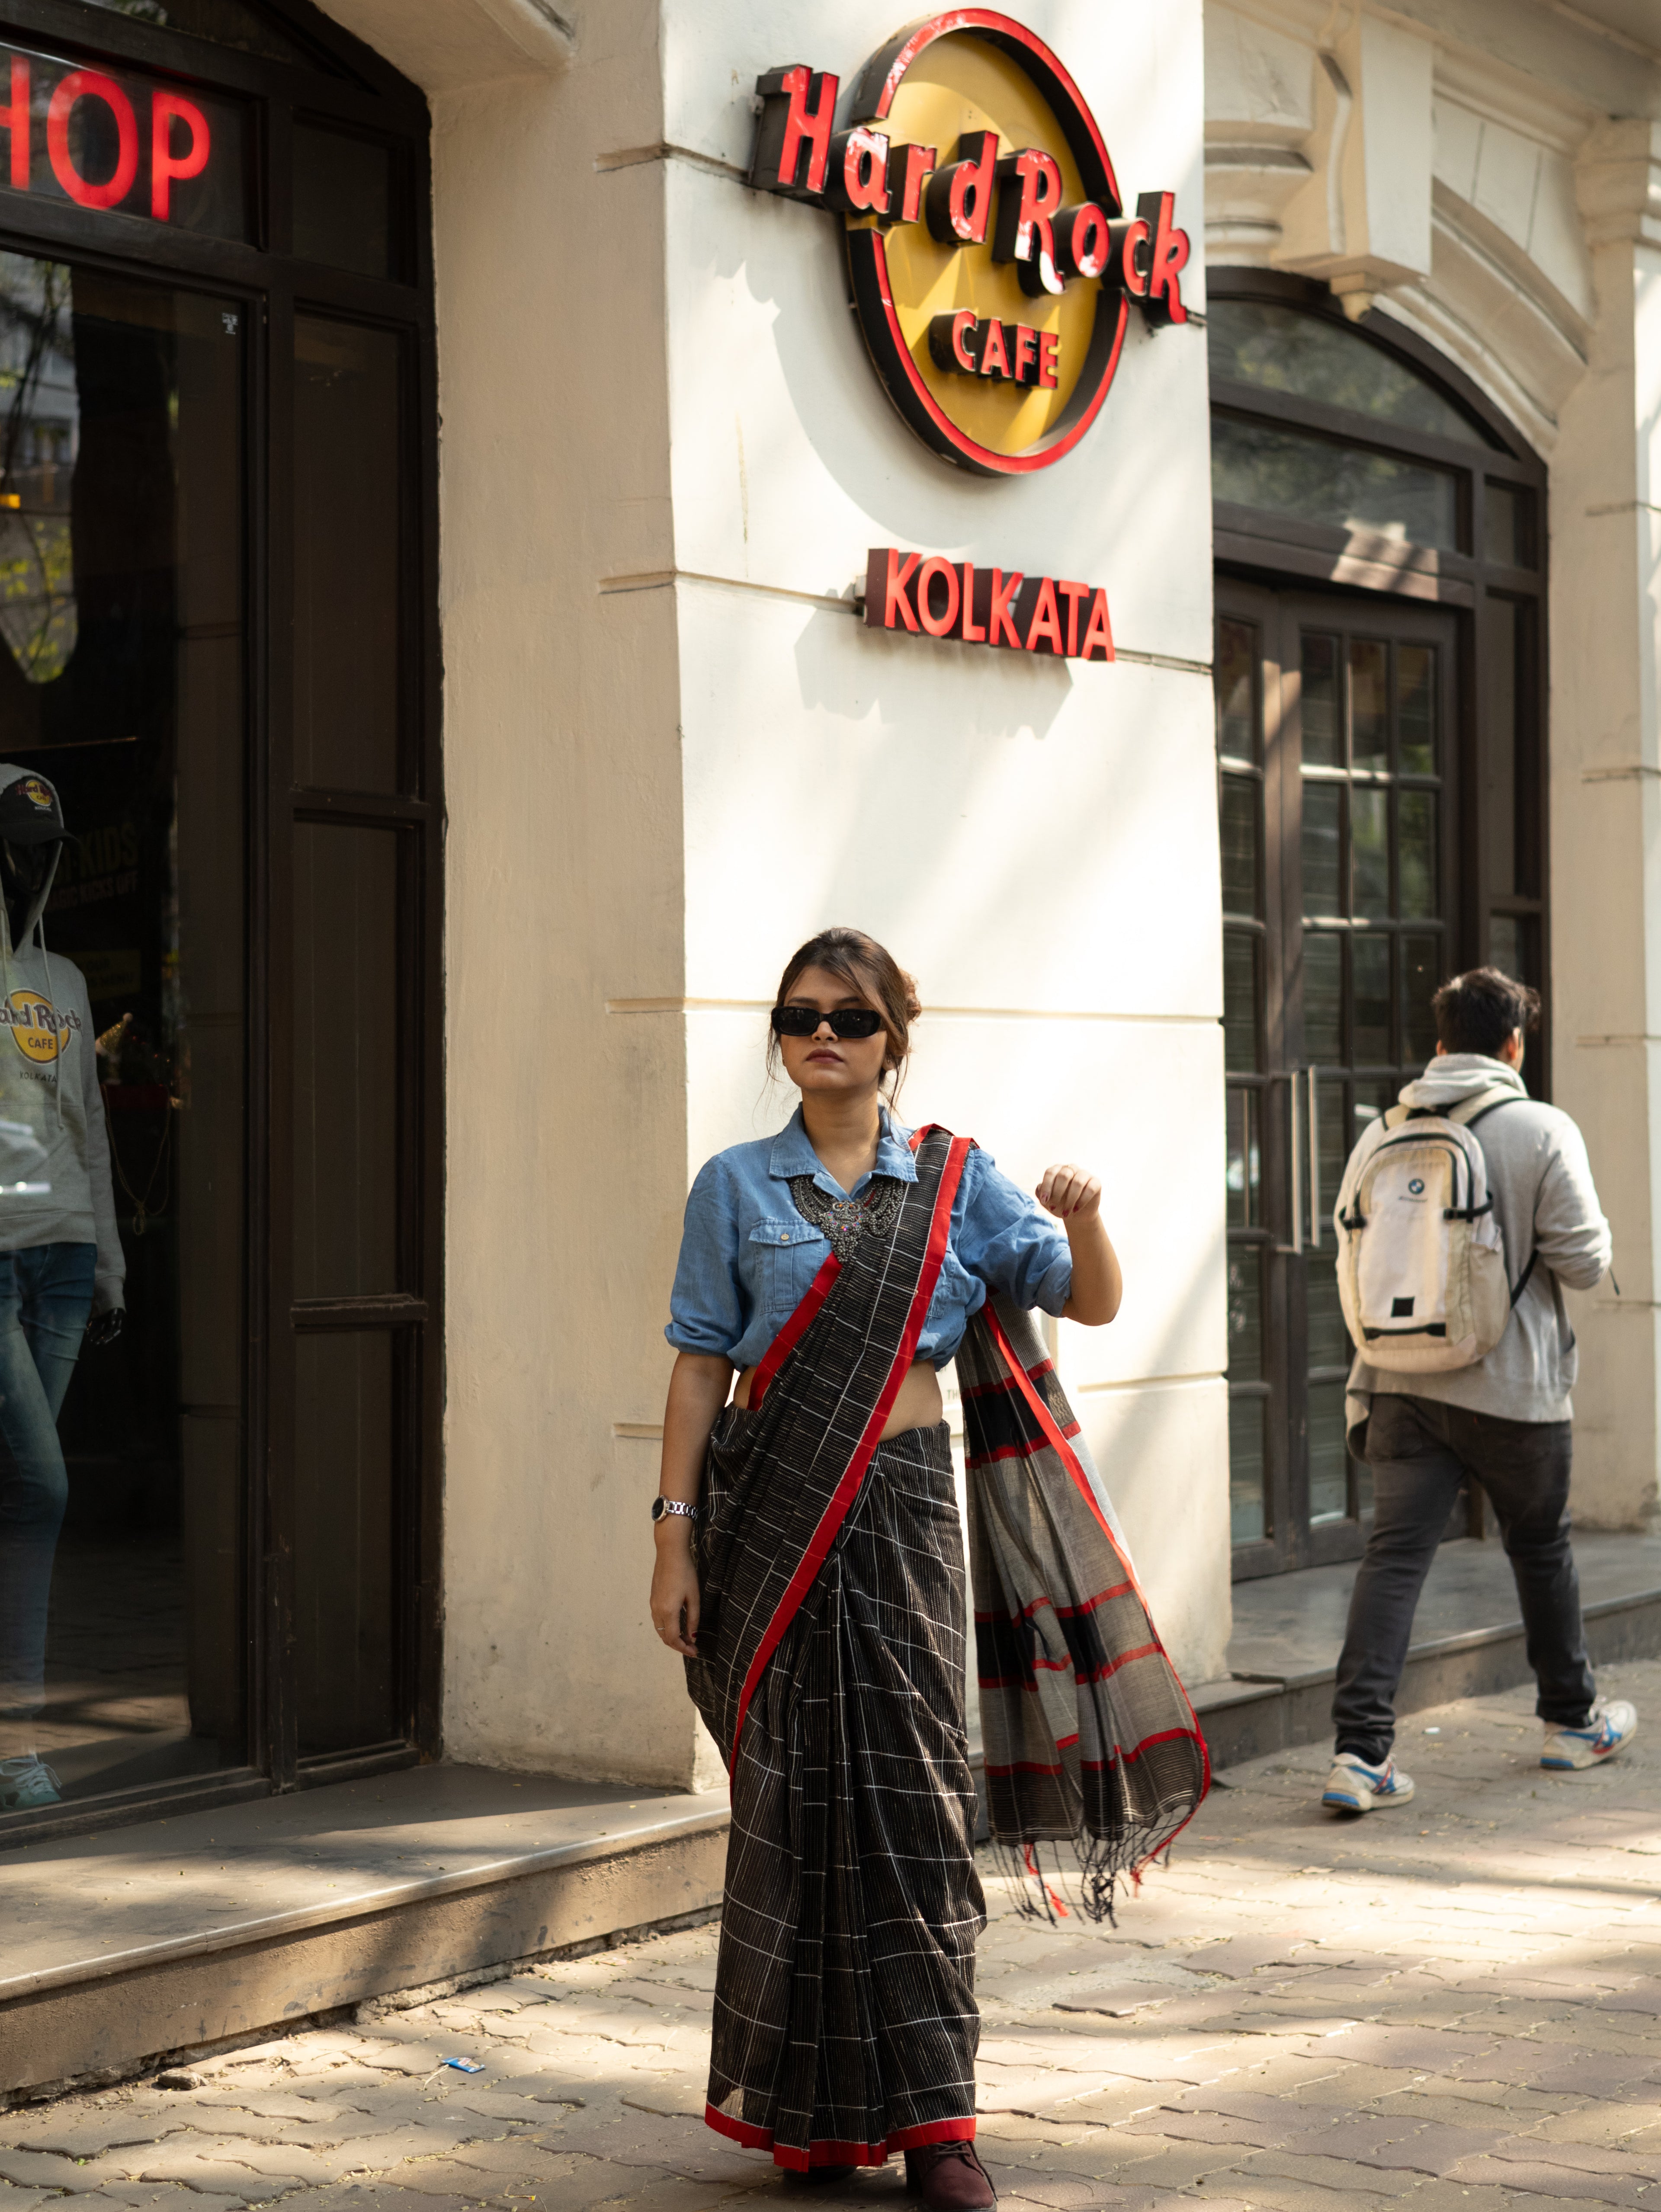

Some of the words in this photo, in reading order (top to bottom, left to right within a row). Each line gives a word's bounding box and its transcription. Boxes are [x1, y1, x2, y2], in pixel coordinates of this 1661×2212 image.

[779, 65, 999, 244] Hard
[1014, 148, 1190, 325] Rock
[952, 309, 1058, 389] CAFE
[885, 548, 1115, 662] KOLKATA
[20, 1070, 58, 1082] KOLKATA
[28, 1037, 54, 1050] CAFE
